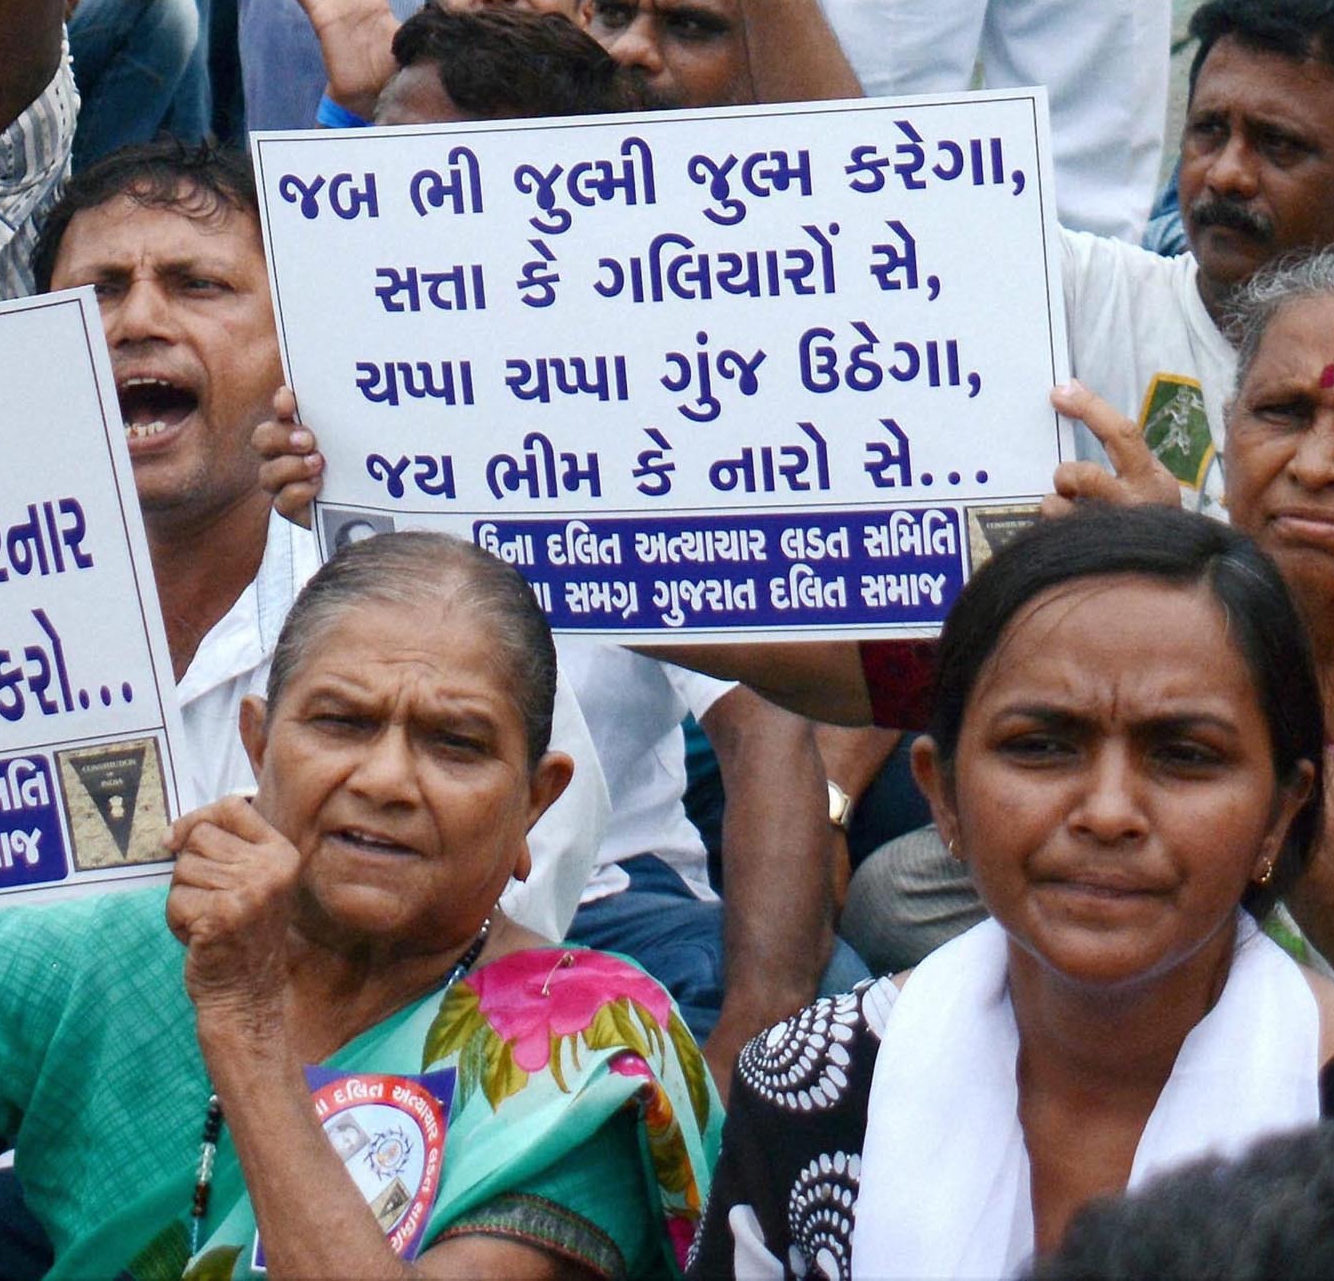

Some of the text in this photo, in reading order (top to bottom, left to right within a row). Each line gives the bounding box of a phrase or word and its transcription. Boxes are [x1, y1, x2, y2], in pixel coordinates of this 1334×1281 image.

[279, 121, 1025, 234] જબ ભી જુલ્મી જુલ્મ કરેગા,
[375, 221, 940, 312] સત્તા કે ગલિયારોં સે,
[356, 322, 981, 422] ચપ્પા ચપ્પા ગુંજ ઉઠેગા,
[366, 423, 830, 499] જય ભીમ કે નારો
[547, 510, 955, 565] દલિત અત્યાચાર લડત સમિતિ
[565, 582, 638, 619] સમગ્ર
[653, 579, 756, 626] ગુજરાત
[770, 564, 846, 609] દલિત
[861, 574, 946, 606] સમાજ
[333, 1079, 384, 1102] દલિત
